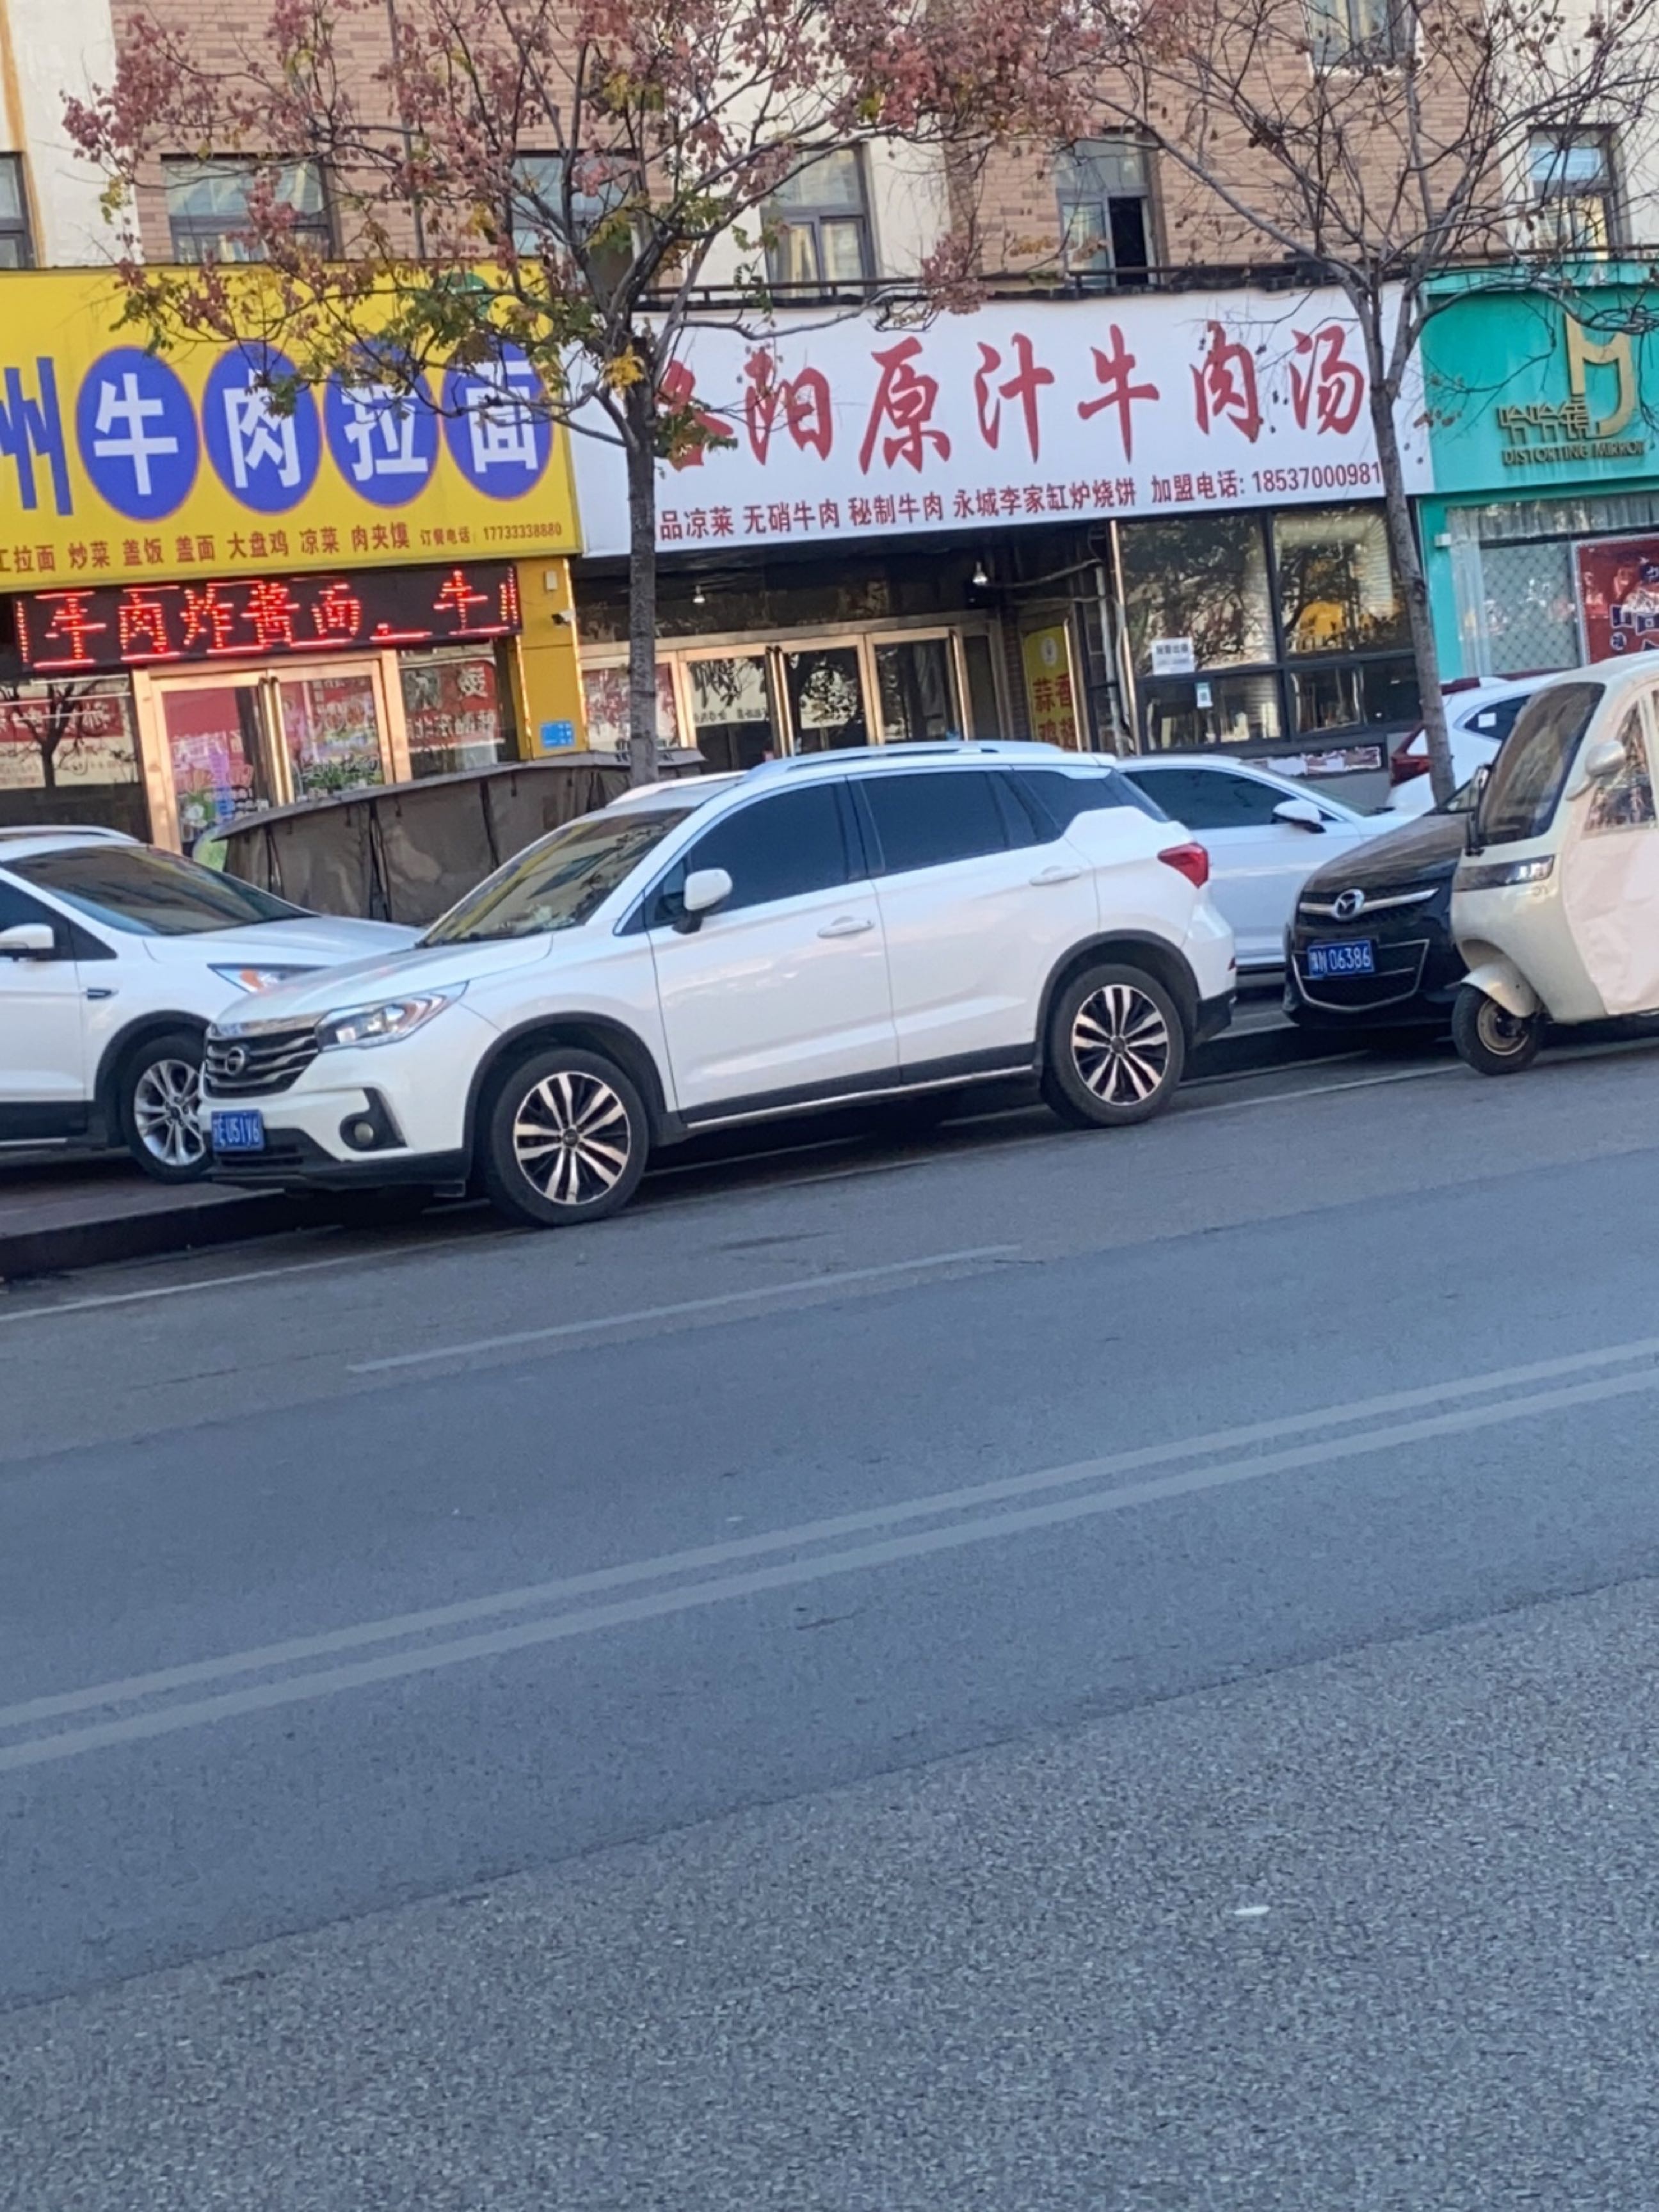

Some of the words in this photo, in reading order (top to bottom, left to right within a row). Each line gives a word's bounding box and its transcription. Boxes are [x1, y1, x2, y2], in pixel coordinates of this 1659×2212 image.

[742, 497, 840, 534] 无硝牛肉
[848, 490, 944, 527] 秘制牛肉
[953, 476, 1136, 519] 永城李家缸炉烧饼
[68, 540, 111, 570] 炒菜
[122, 538, 164, 567] 盖饭
[175, 534, 216, 564] 盖面
[227, 529, 289, 560] 大盘鸡
[299, 526, 340, 555] 凉菜
